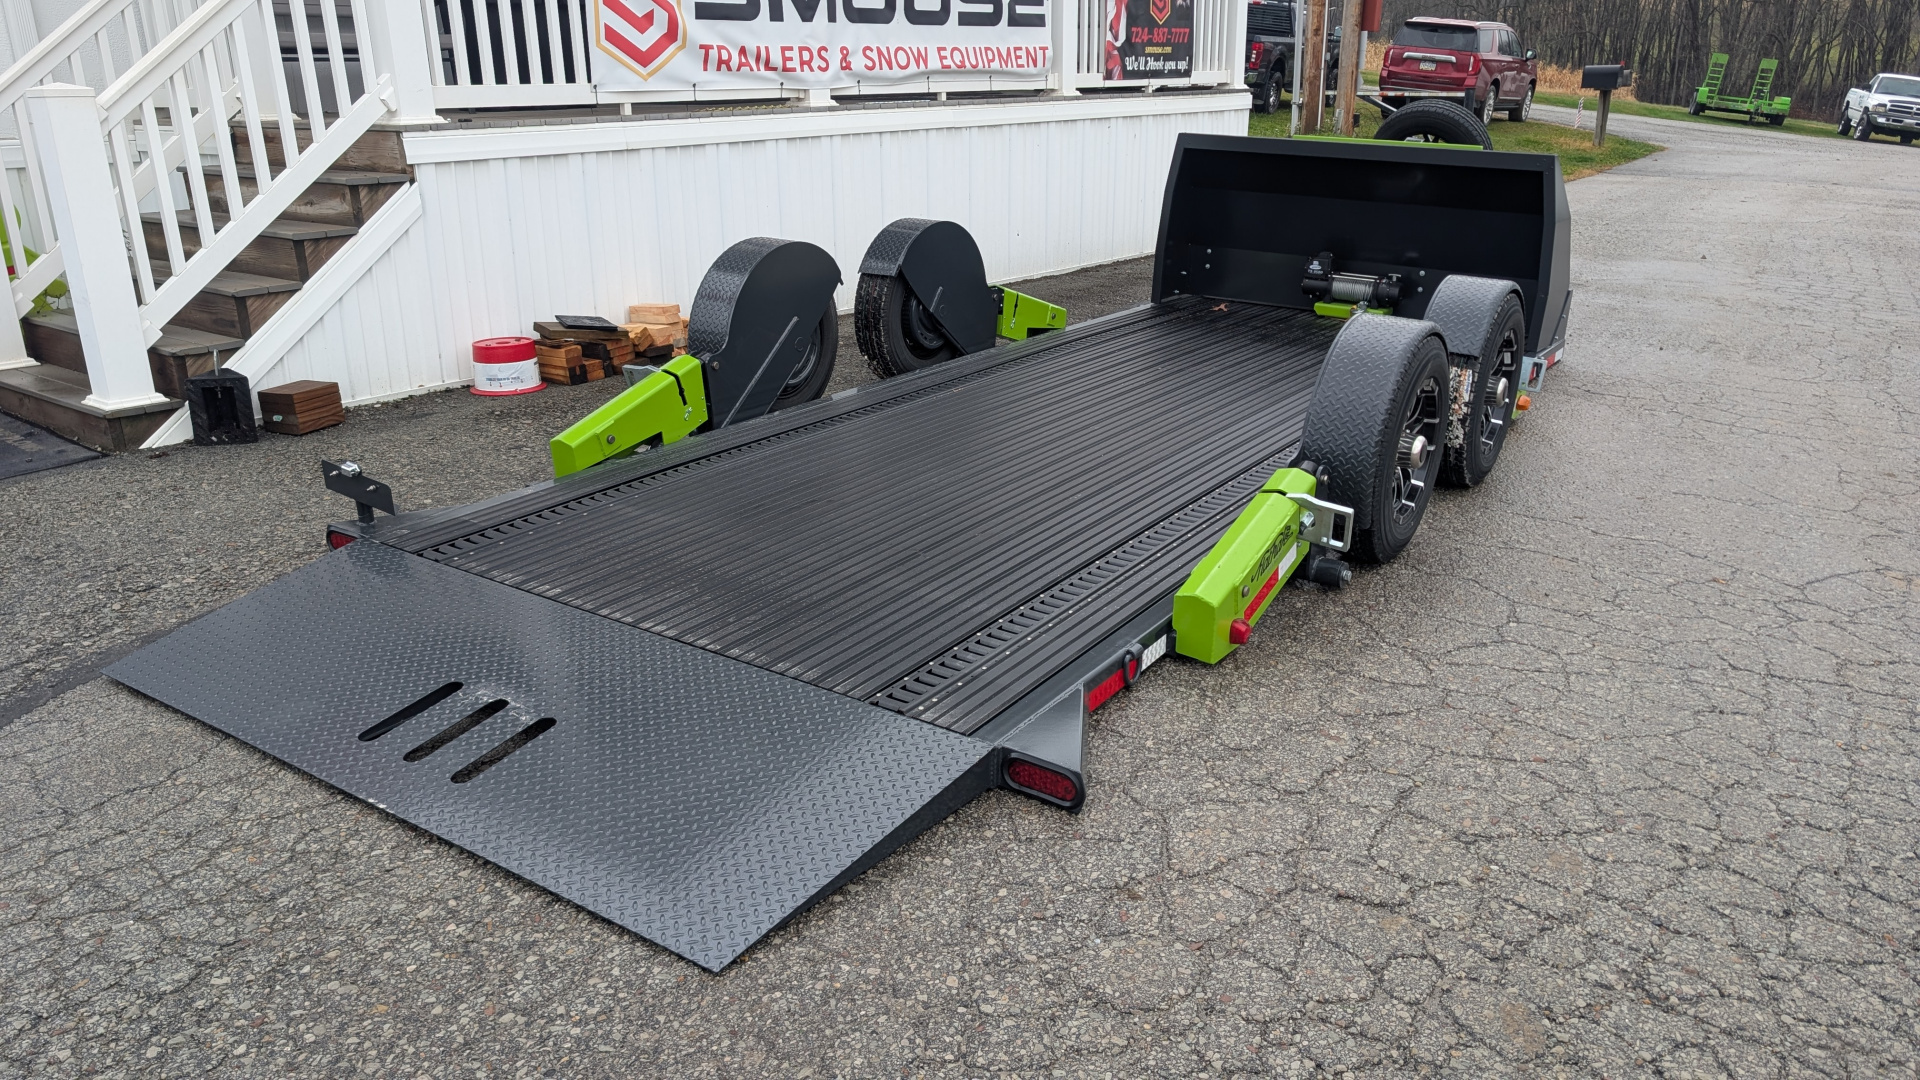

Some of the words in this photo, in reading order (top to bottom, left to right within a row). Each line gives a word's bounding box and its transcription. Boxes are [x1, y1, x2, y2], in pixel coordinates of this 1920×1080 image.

[1131, 27, 1190, 43] 724-887-7777
[698, 43, 830, 73] TRAILERS
[839, 45, 853, 71] &
[861, 46, 929, 71] SNOW
[936, 46, 1049, 70] EQUIPMENT
[1124, 55, 1146, 71] We'll
[1146, 56, 1164, 71] Hook
[1164, 60, 1176, 73] you
[1177, 56, 1189, 73] up!
